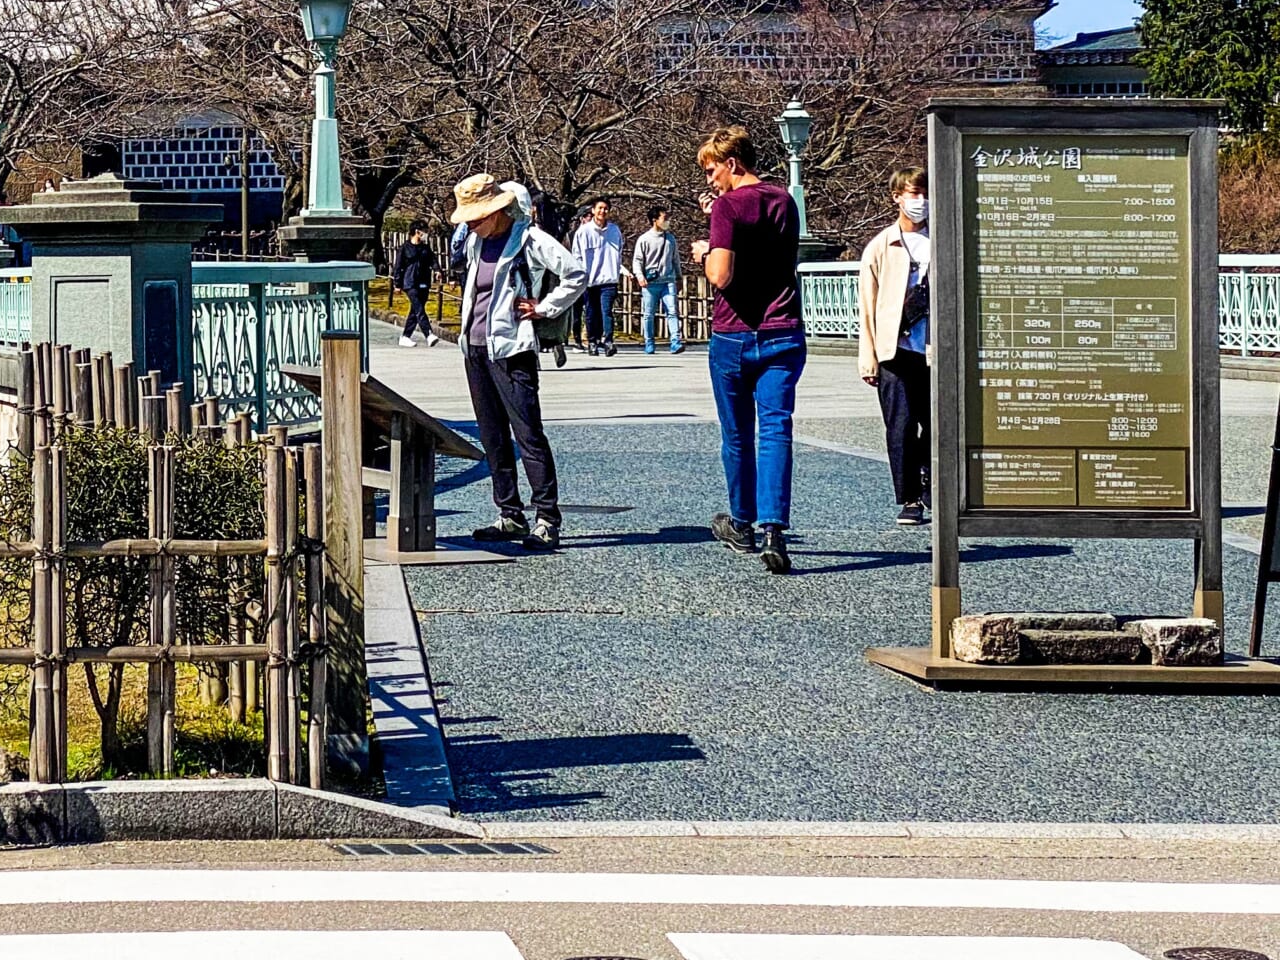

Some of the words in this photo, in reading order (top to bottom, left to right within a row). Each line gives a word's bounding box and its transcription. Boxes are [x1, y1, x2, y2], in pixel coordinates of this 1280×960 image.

[969, 145, 1082, 170] 金沢城公園
[1024, 319, 1051, 328] 320円
[1074, 320, 1101, 329] 250円
[1025, 336, 1051, 345] 100円
